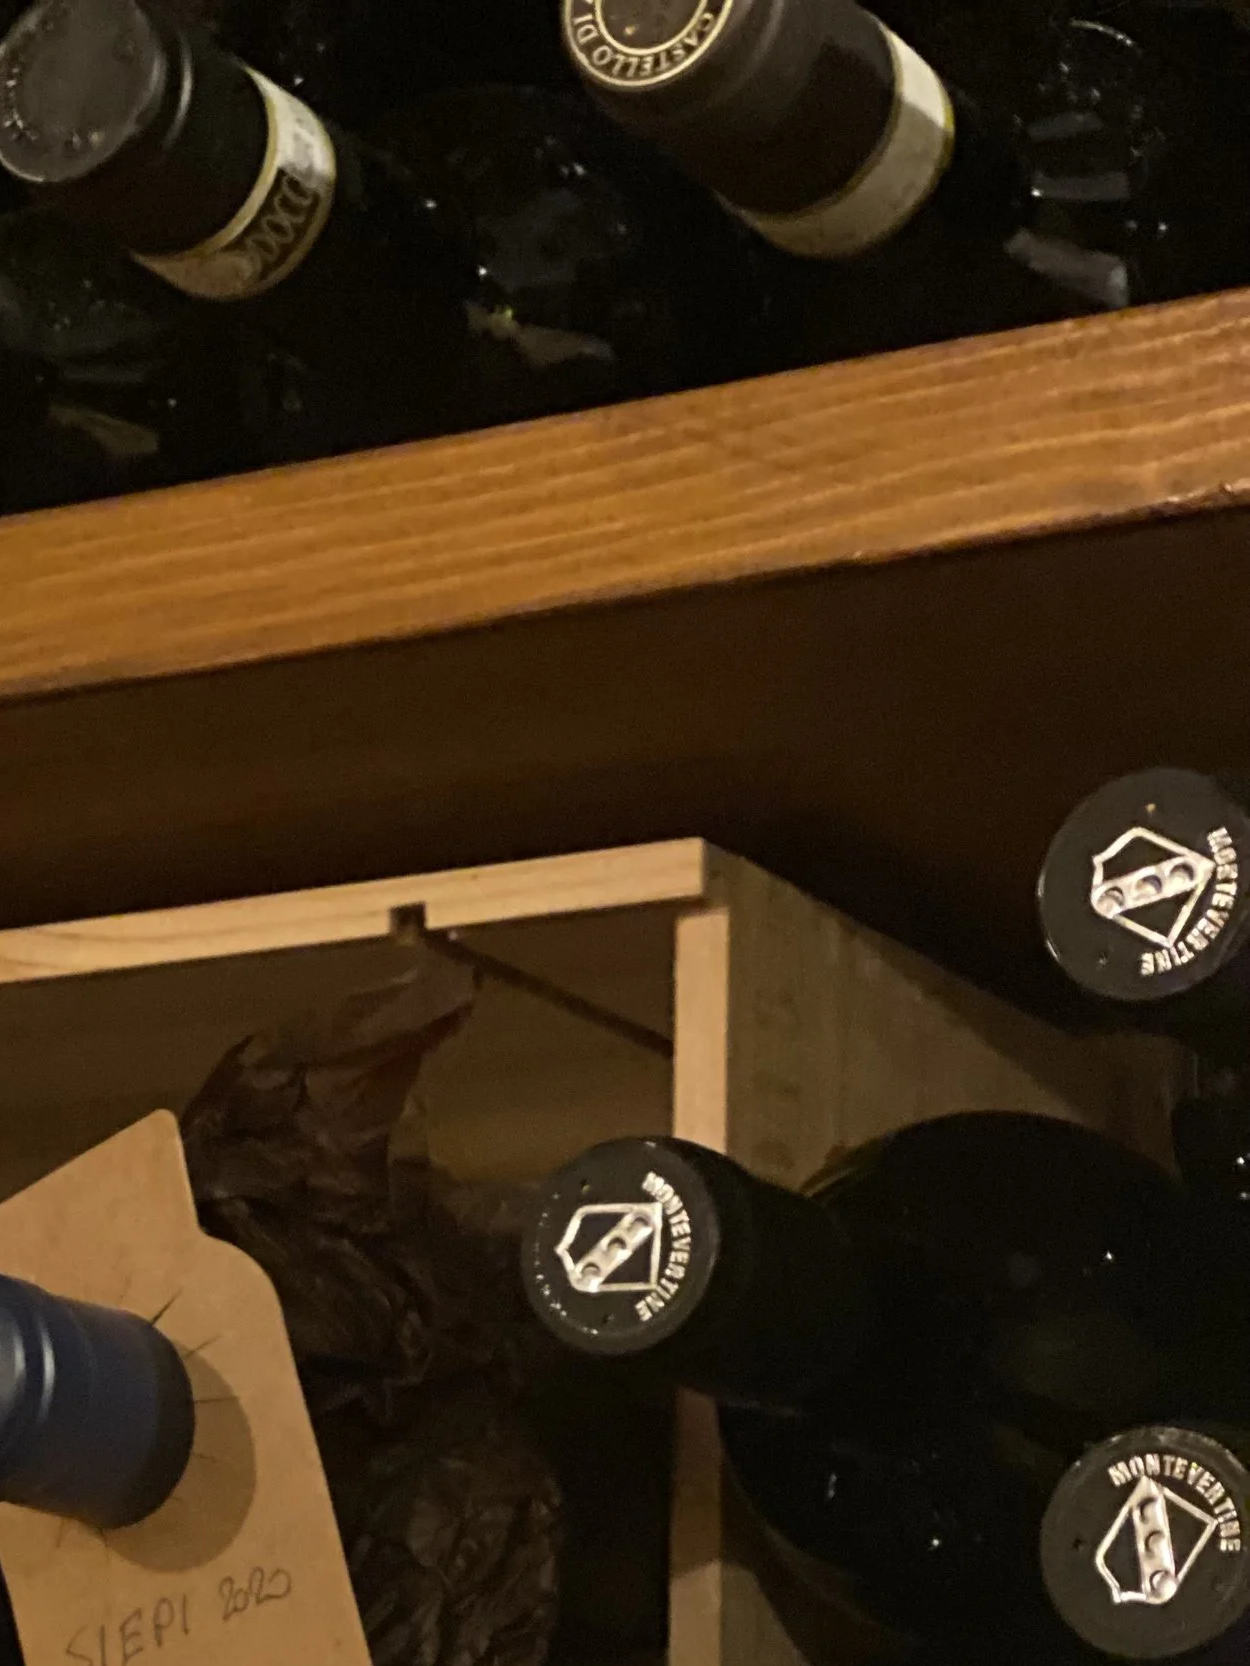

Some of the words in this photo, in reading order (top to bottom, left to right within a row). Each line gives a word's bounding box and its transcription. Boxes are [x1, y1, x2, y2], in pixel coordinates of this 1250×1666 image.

[572, 13, 600, 45] DI
[591, 12, 715, 78] CASTELLO
[1140, 826, 1239, 976] MONTEVERTINE
[634, 1171, 692, 1322] MONTEVERTINE
[1107, 1452, 1242, 1552] MONTEVERTINE
